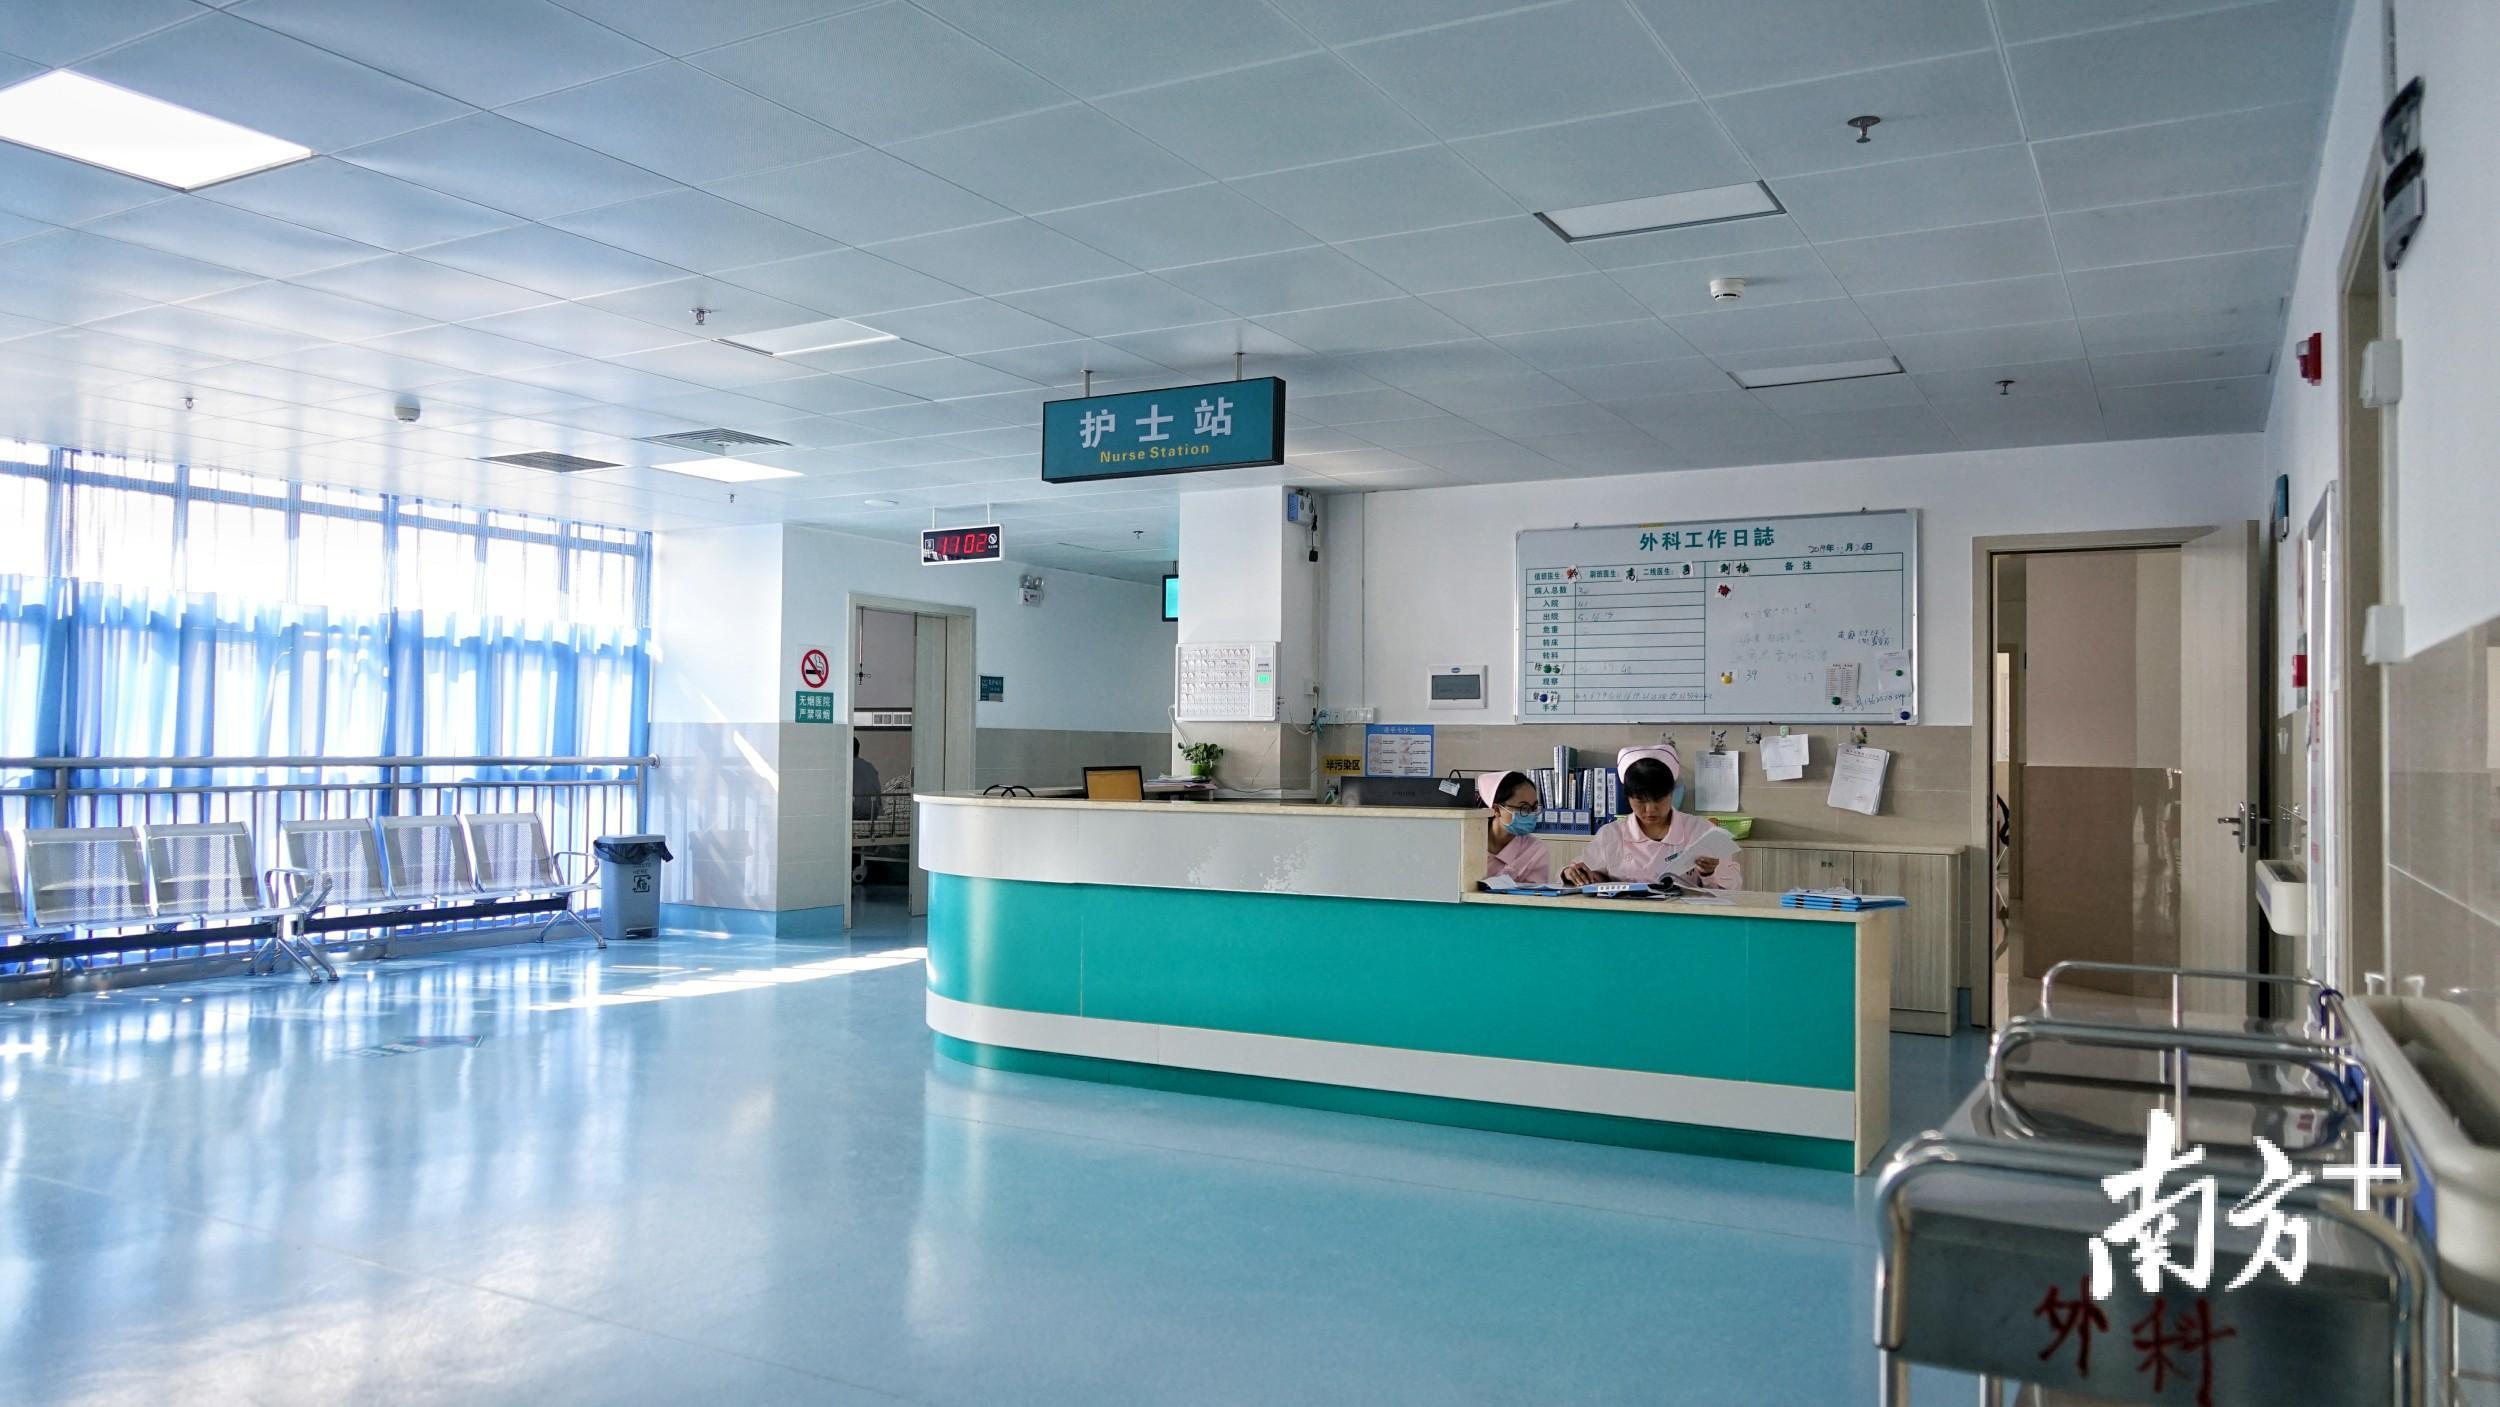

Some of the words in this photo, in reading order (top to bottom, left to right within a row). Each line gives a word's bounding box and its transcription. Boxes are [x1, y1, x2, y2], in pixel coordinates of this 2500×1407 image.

[1080, 396, 1234, 449] 护士站
[1100, 449, 1146, 463] Nurse
[1149, 443, 1210, 459] Station
[1639, 526, 1775, 551] 外科工作日誌
[1534, 586, 1567, 595] 病人总数
[1543, 599, 1559, 608] 入院
[1542, 612, 1559, 621] 出院
[799, 695, 832, 708] 无烟医院
[799, 708, 831, 721] 严禁吸烟
[1325, 759, 1361, 771] 半污染区
[2034, 1276, 2237, 1407] 外科
